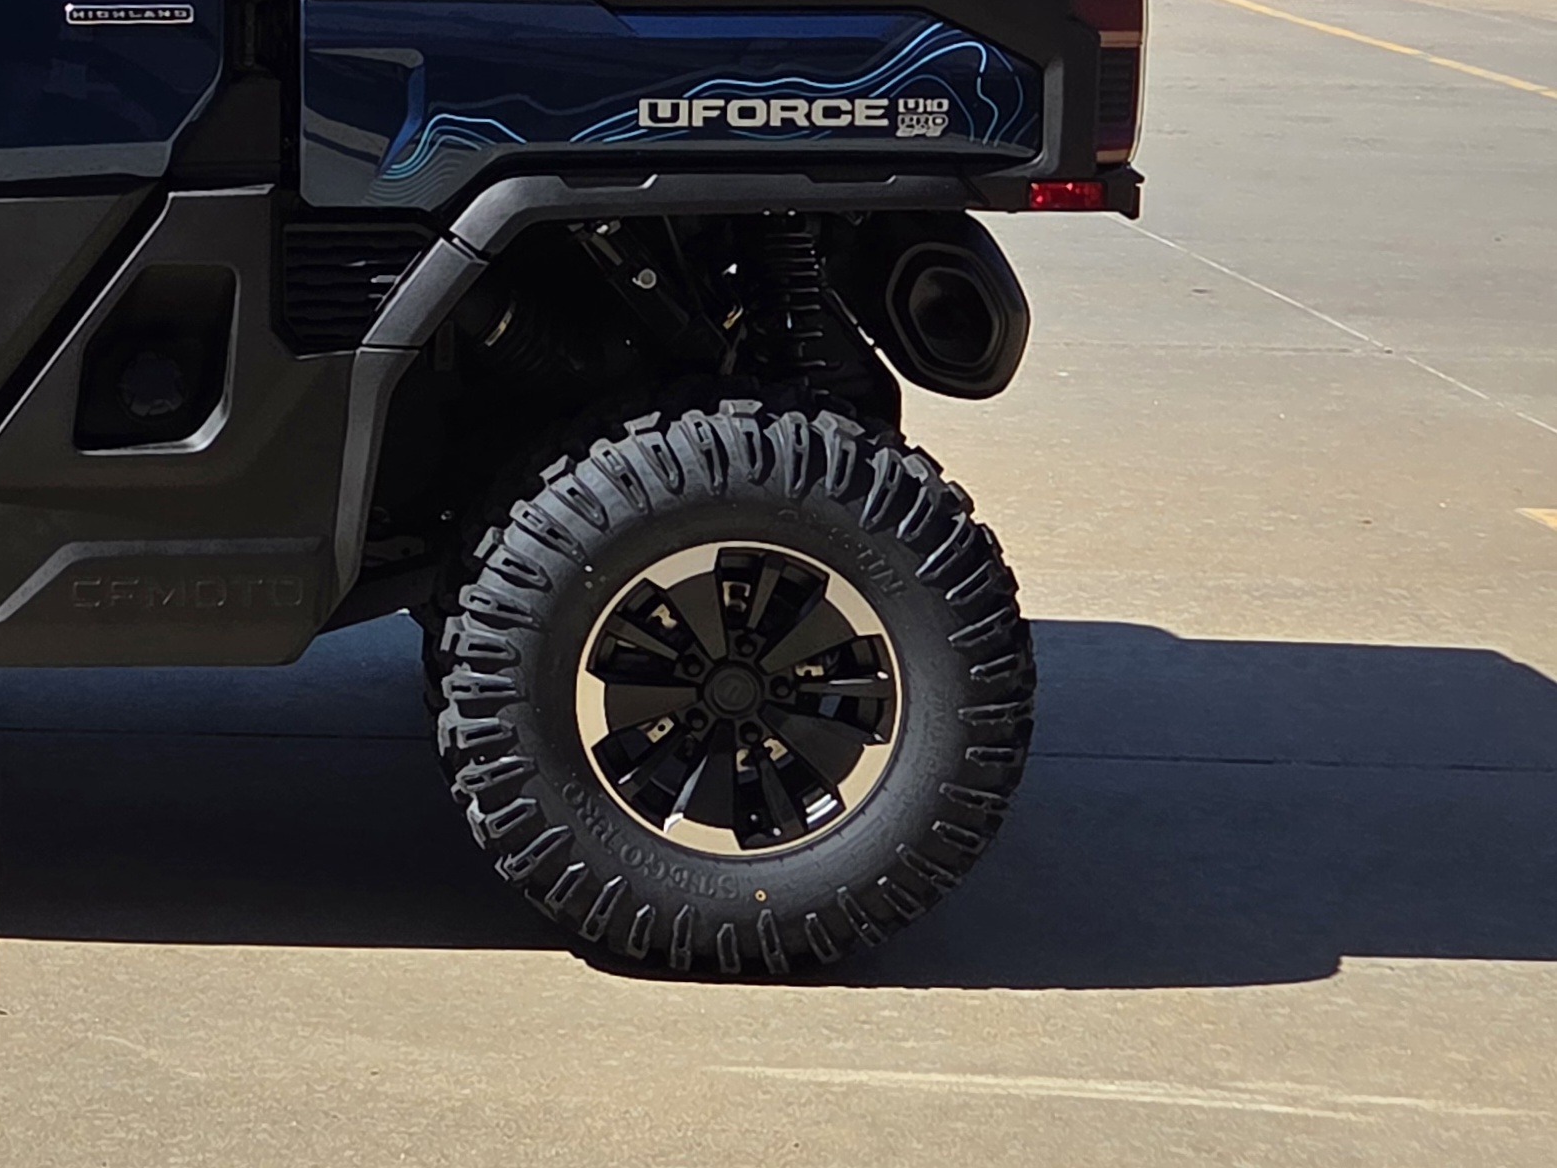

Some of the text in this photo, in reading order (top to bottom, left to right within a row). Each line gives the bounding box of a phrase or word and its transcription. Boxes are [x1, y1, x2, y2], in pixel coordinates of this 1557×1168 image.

[72, 10, 187, 19] HIGHLAND
[639, 98, 889, 127] UFORCE
[72, 578, 304, 607] CFMOTO
